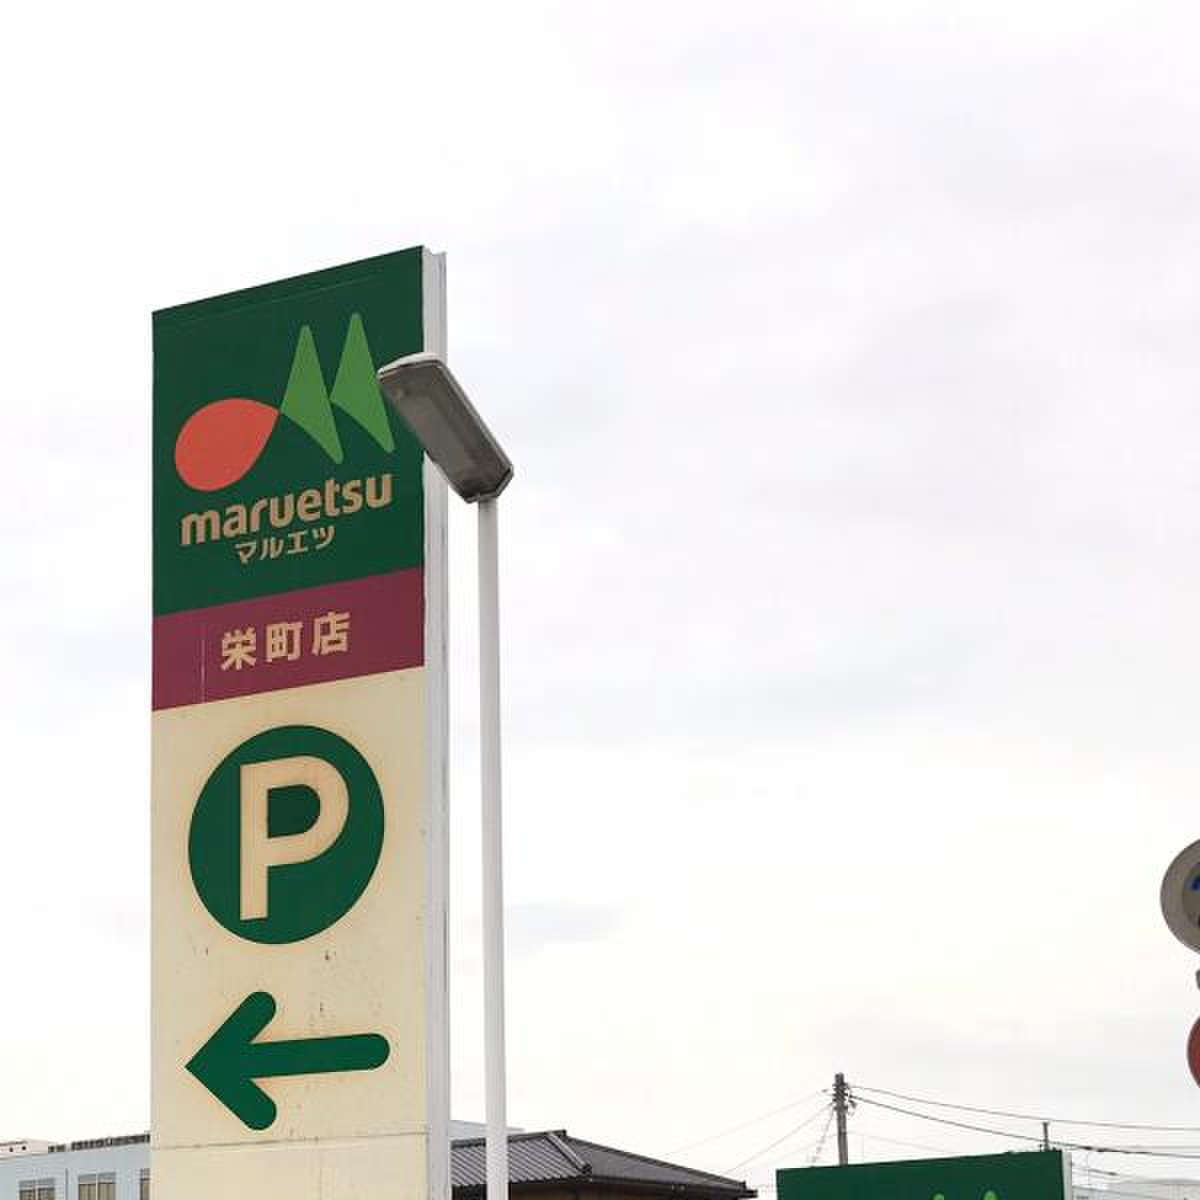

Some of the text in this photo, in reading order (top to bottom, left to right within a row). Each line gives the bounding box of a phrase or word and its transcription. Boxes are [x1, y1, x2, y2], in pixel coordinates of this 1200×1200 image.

[180, 472, 393, 547] maruetsu
[233, 524, 336, 565] マルエツ
[220, 610, 351, 672] 栄町店
[239, 754, 350, 921] P
